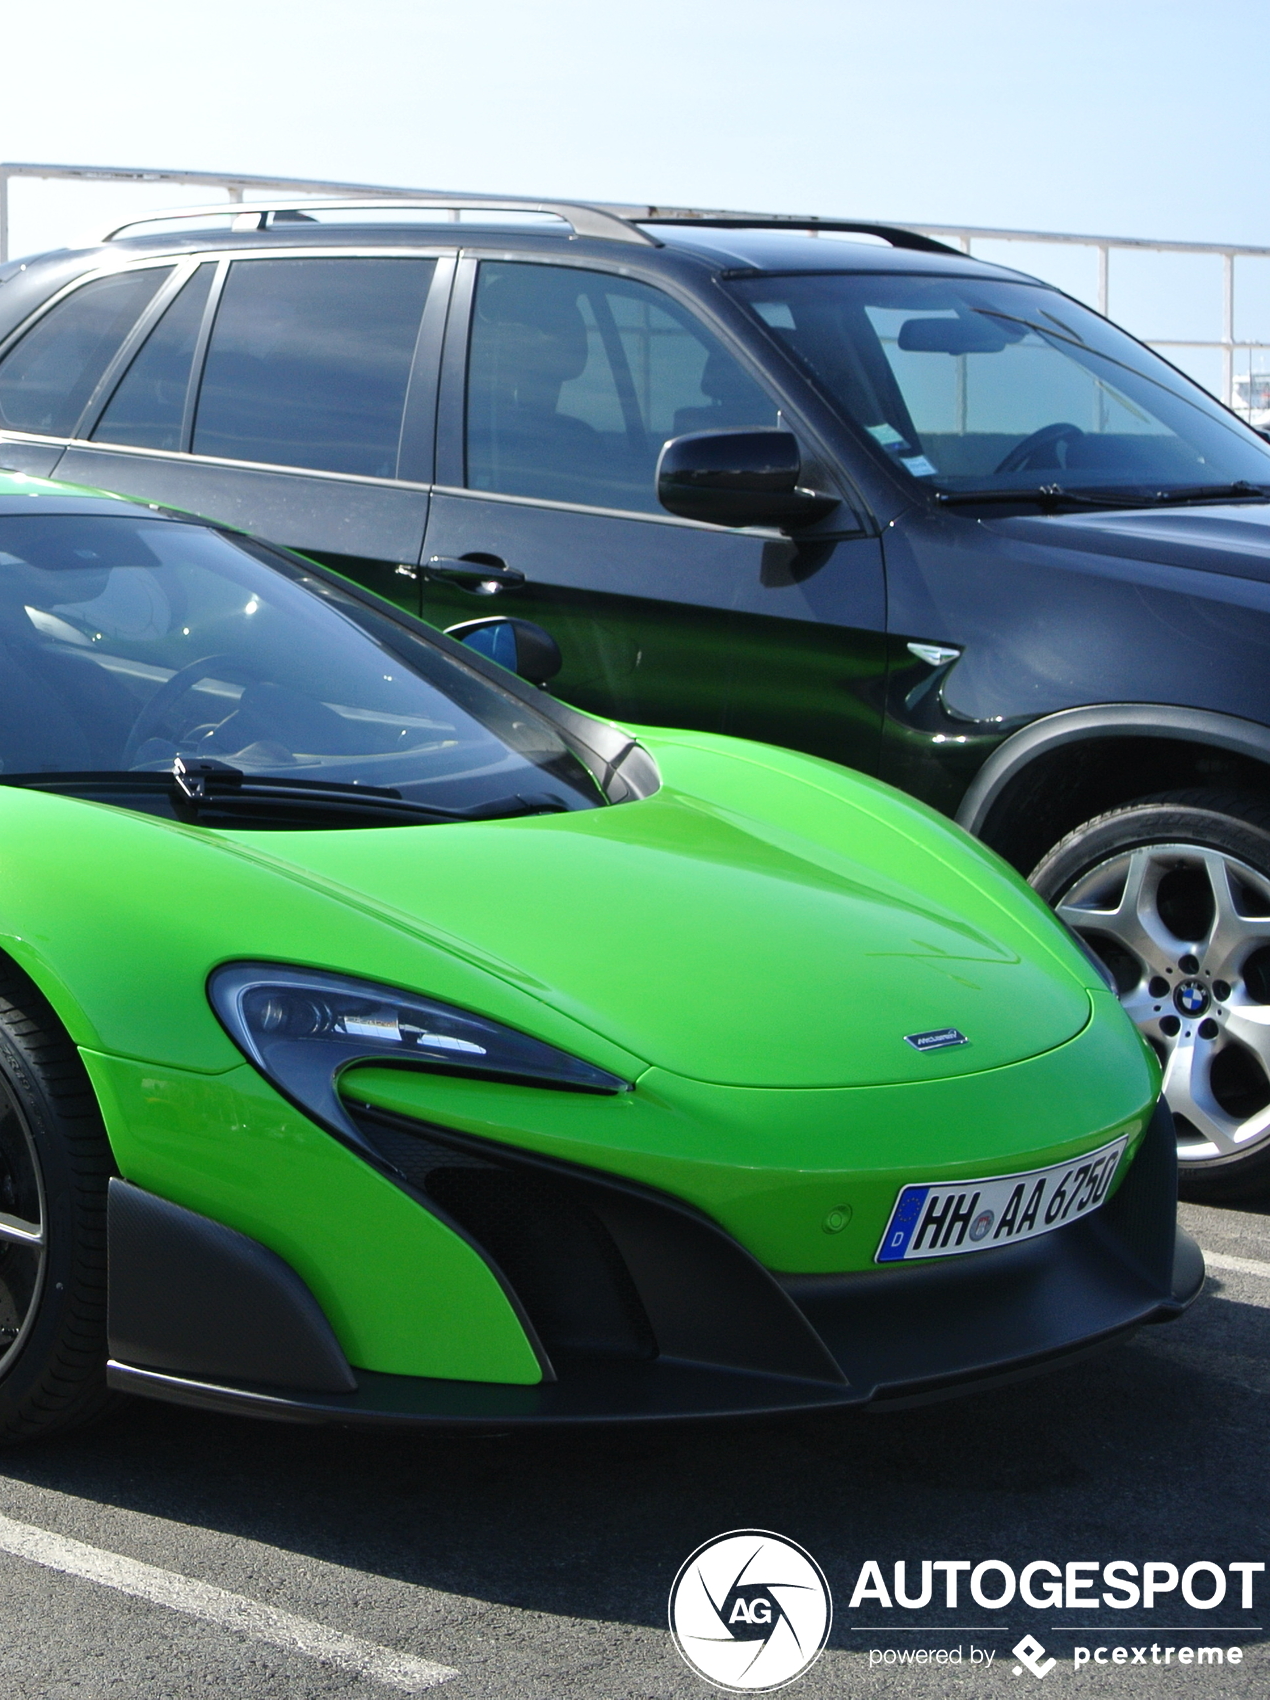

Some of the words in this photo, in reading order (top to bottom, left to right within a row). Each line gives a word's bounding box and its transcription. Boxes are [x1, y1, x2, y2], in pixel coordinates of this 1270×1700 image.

[912, 1192, 980, 1250] HH
[993, 1177, 1047, 1239] AA
[1045, 1150, 1119, 1225] 6750
[891, 1231, 904, 1247] D
